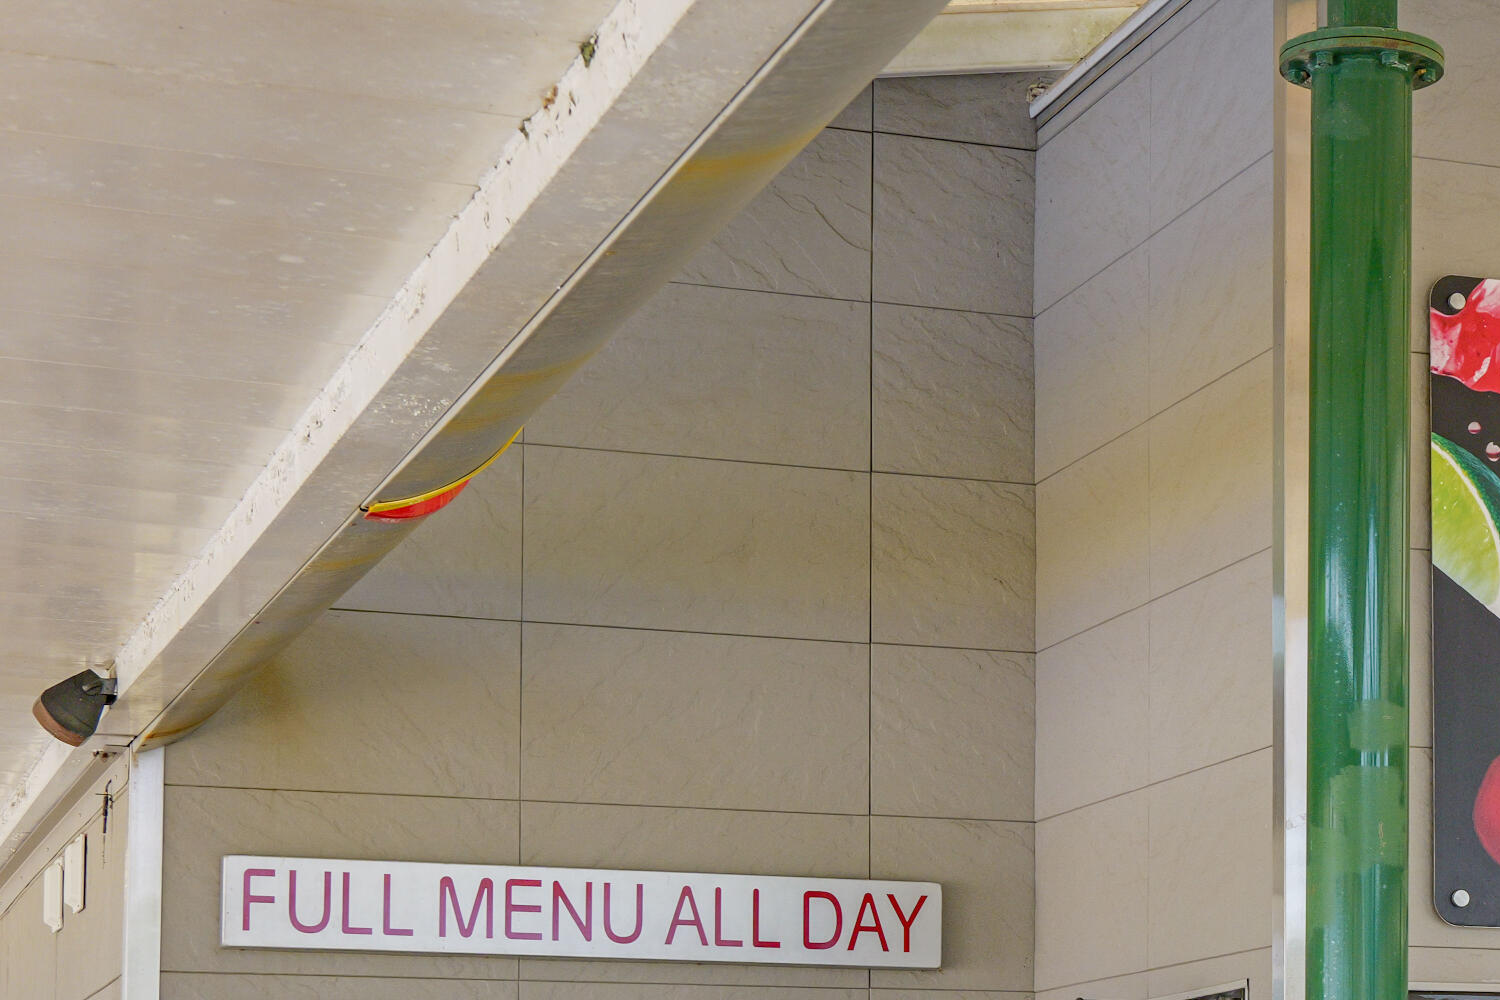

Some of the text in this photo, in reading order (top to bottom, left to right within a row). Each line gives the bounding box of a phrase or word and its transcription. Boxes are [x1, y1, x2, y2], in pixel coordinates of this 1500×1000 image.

[241, 867, 928, 954] FULL MENU ALL DAY
